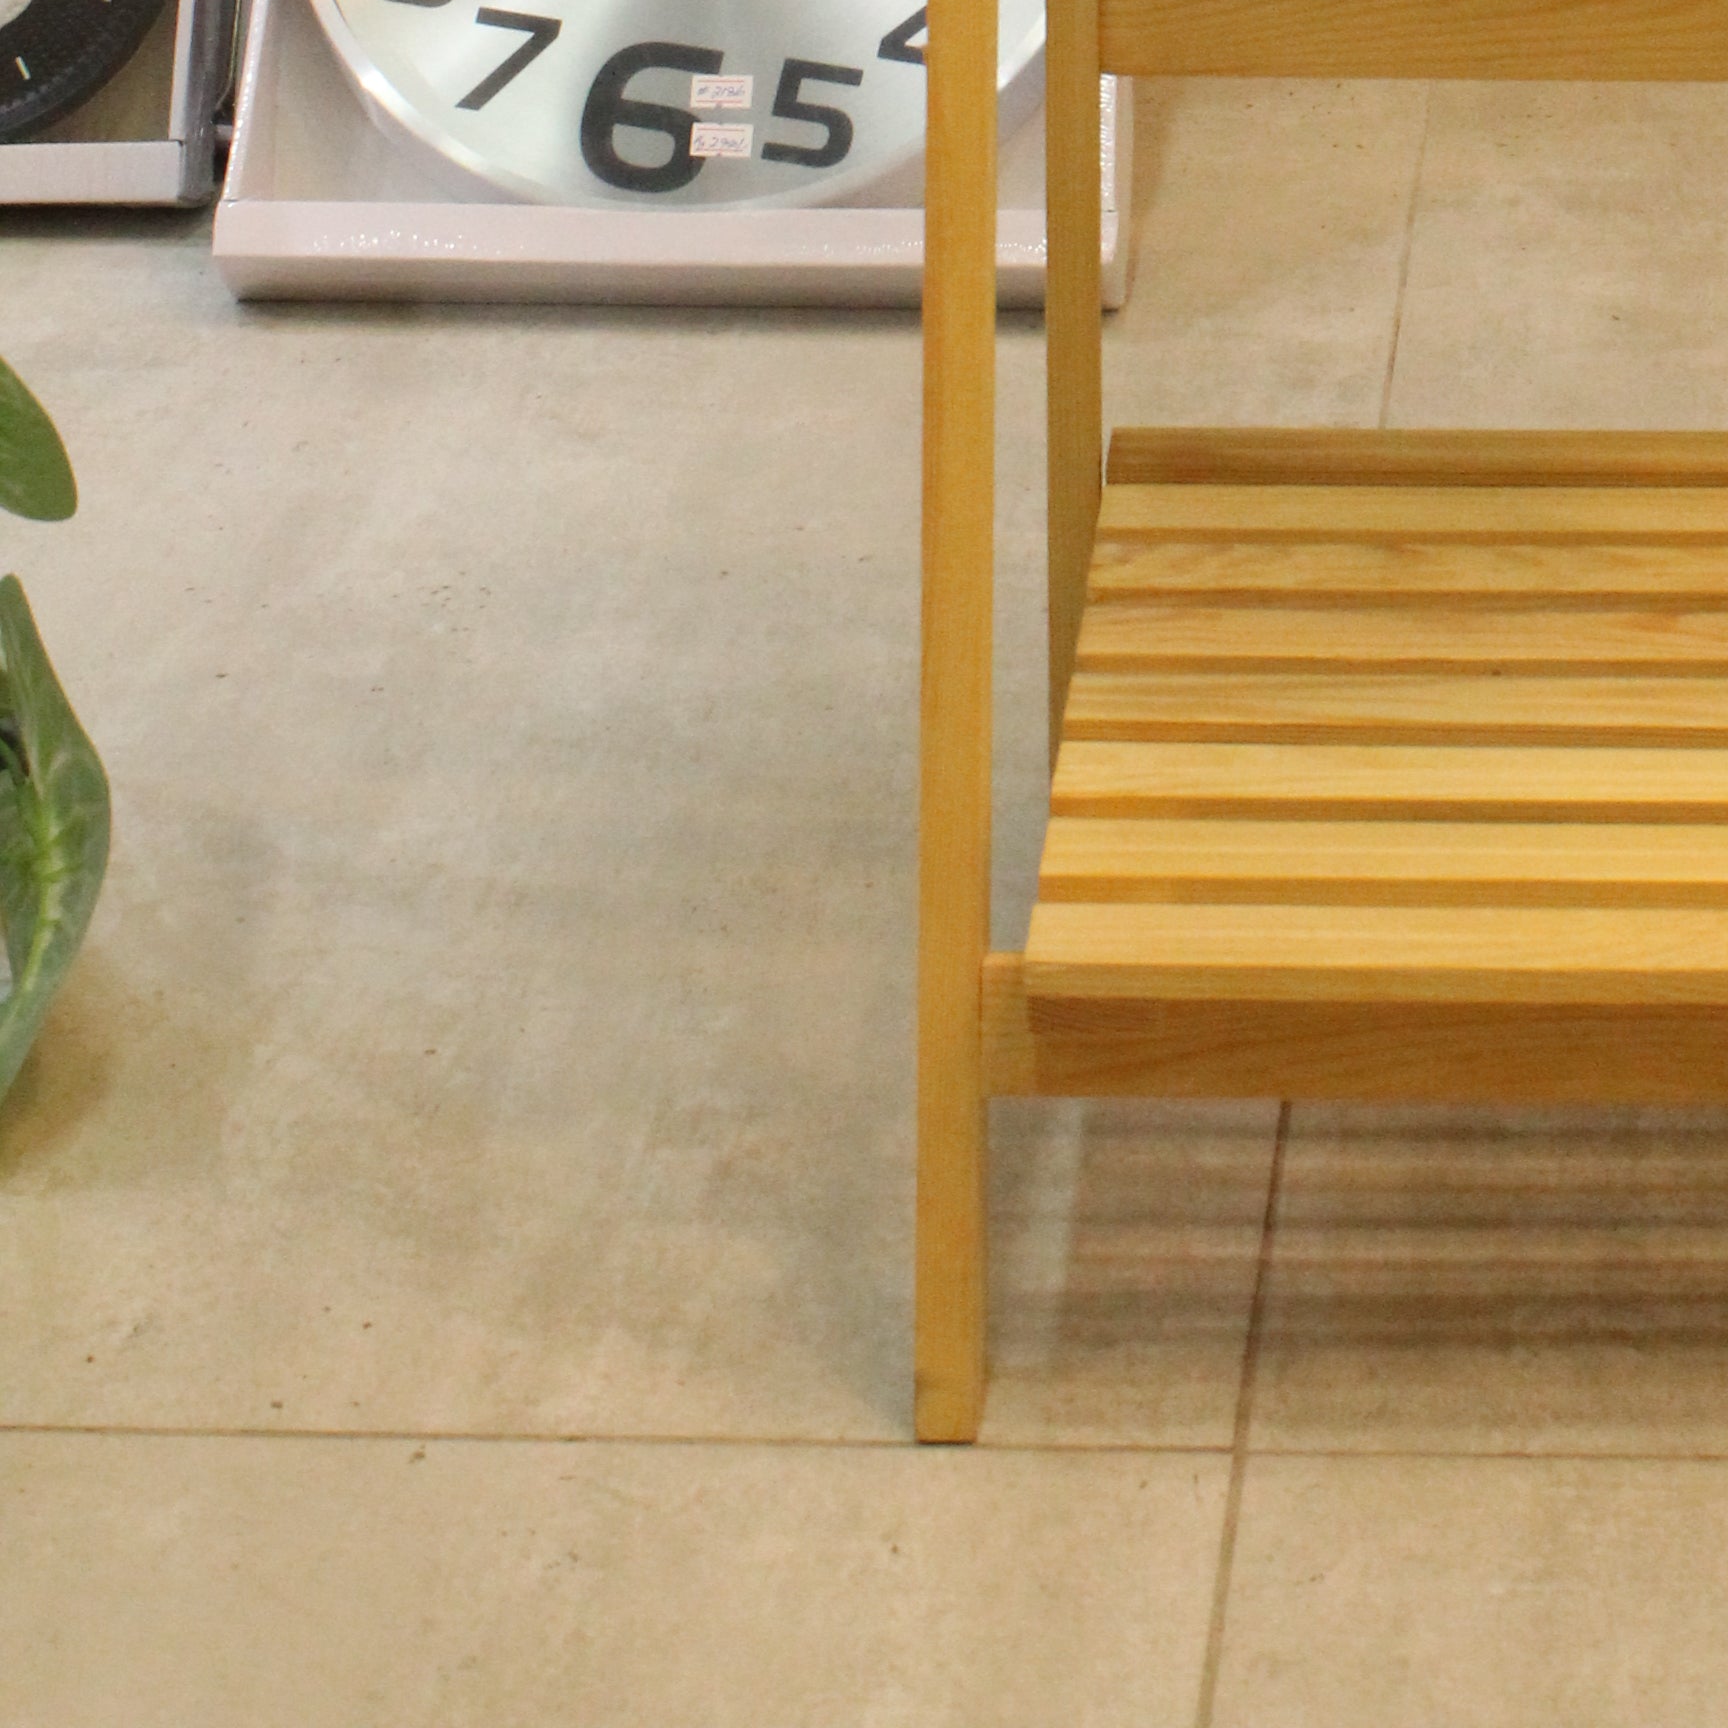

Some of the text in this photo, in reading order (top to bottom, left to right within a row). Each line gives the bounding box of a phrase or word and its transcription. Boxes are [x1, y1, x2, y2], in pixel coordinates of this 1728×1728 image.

[455, 6, 562, 111] 7
[760, 57, 865, 169] 5
[579, 41, 724, 194] 6
